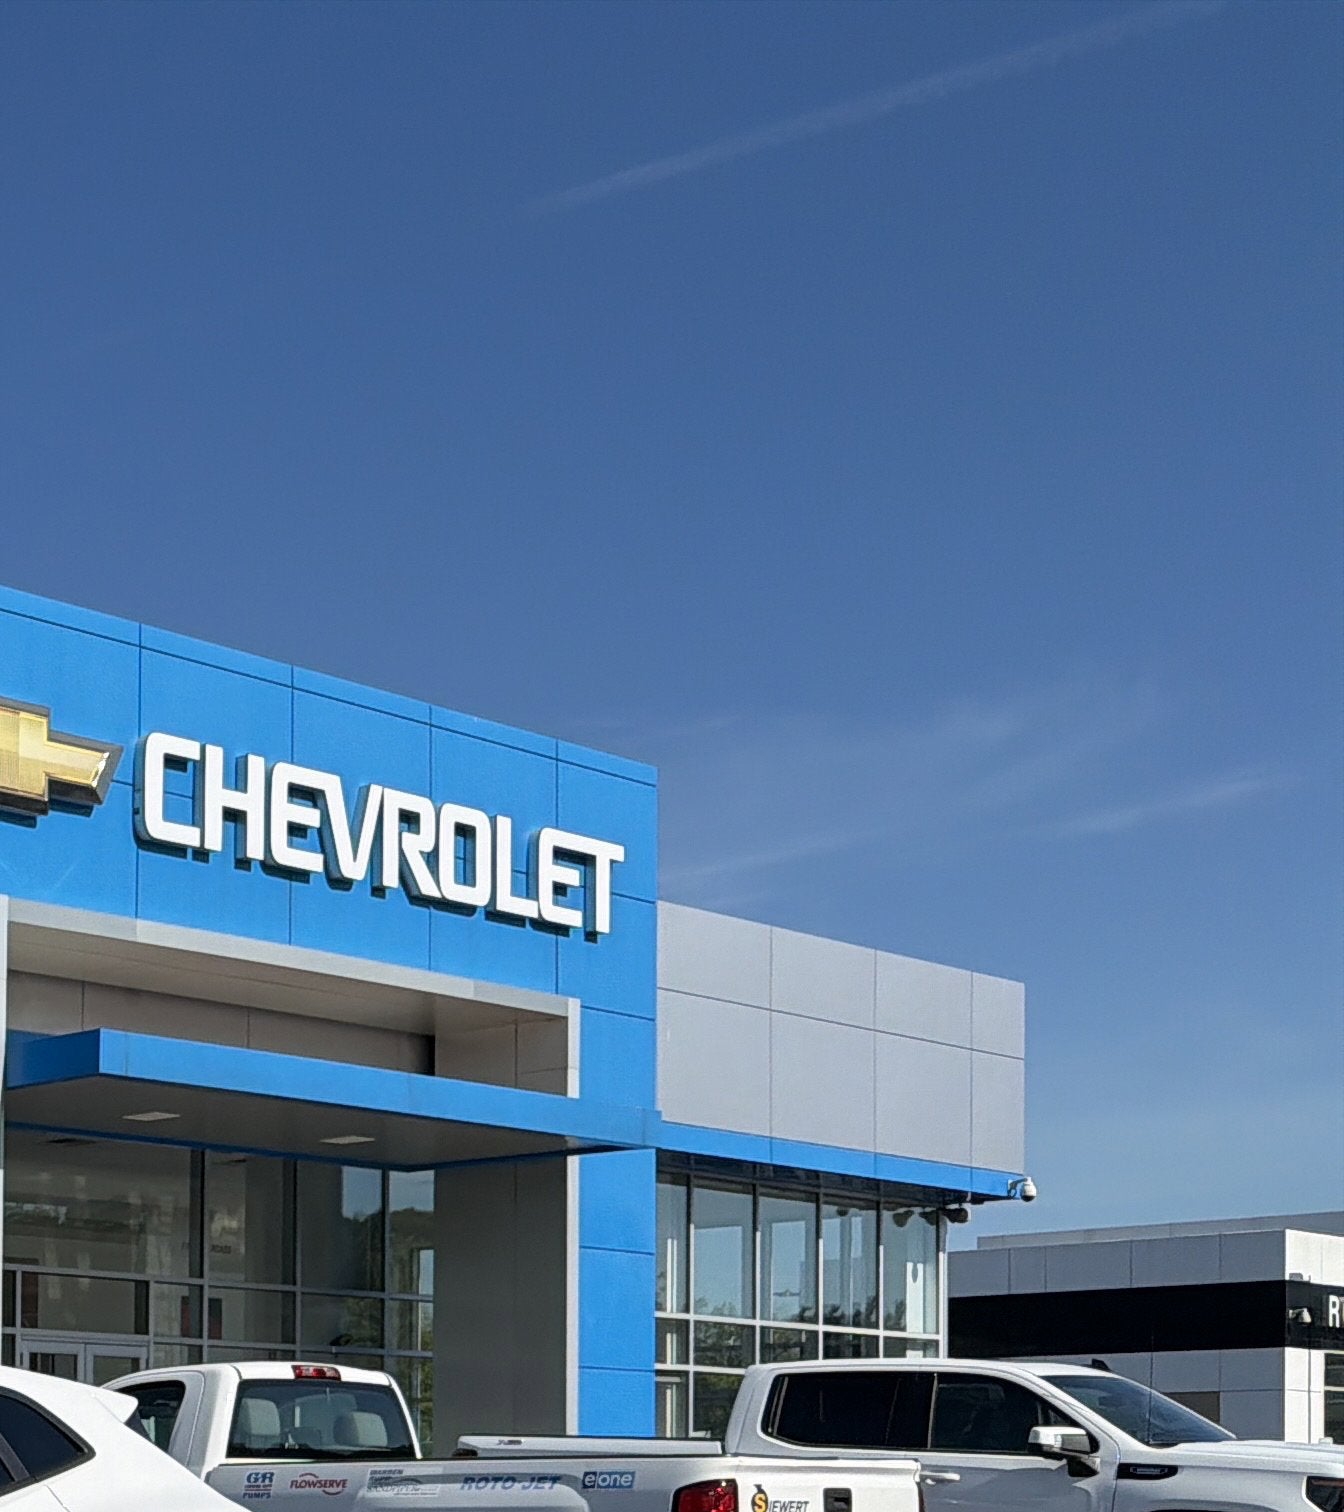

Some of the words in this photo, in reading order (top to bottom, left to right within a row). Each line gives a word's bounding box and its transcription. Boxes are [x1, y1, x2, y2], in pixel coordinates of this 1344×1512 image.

[136, 731, 626, 935] CHEVROLET
[289, 1478, 348, 1490] FLOWSERVE
[242, 1492, 272, 1500] PUMPS
